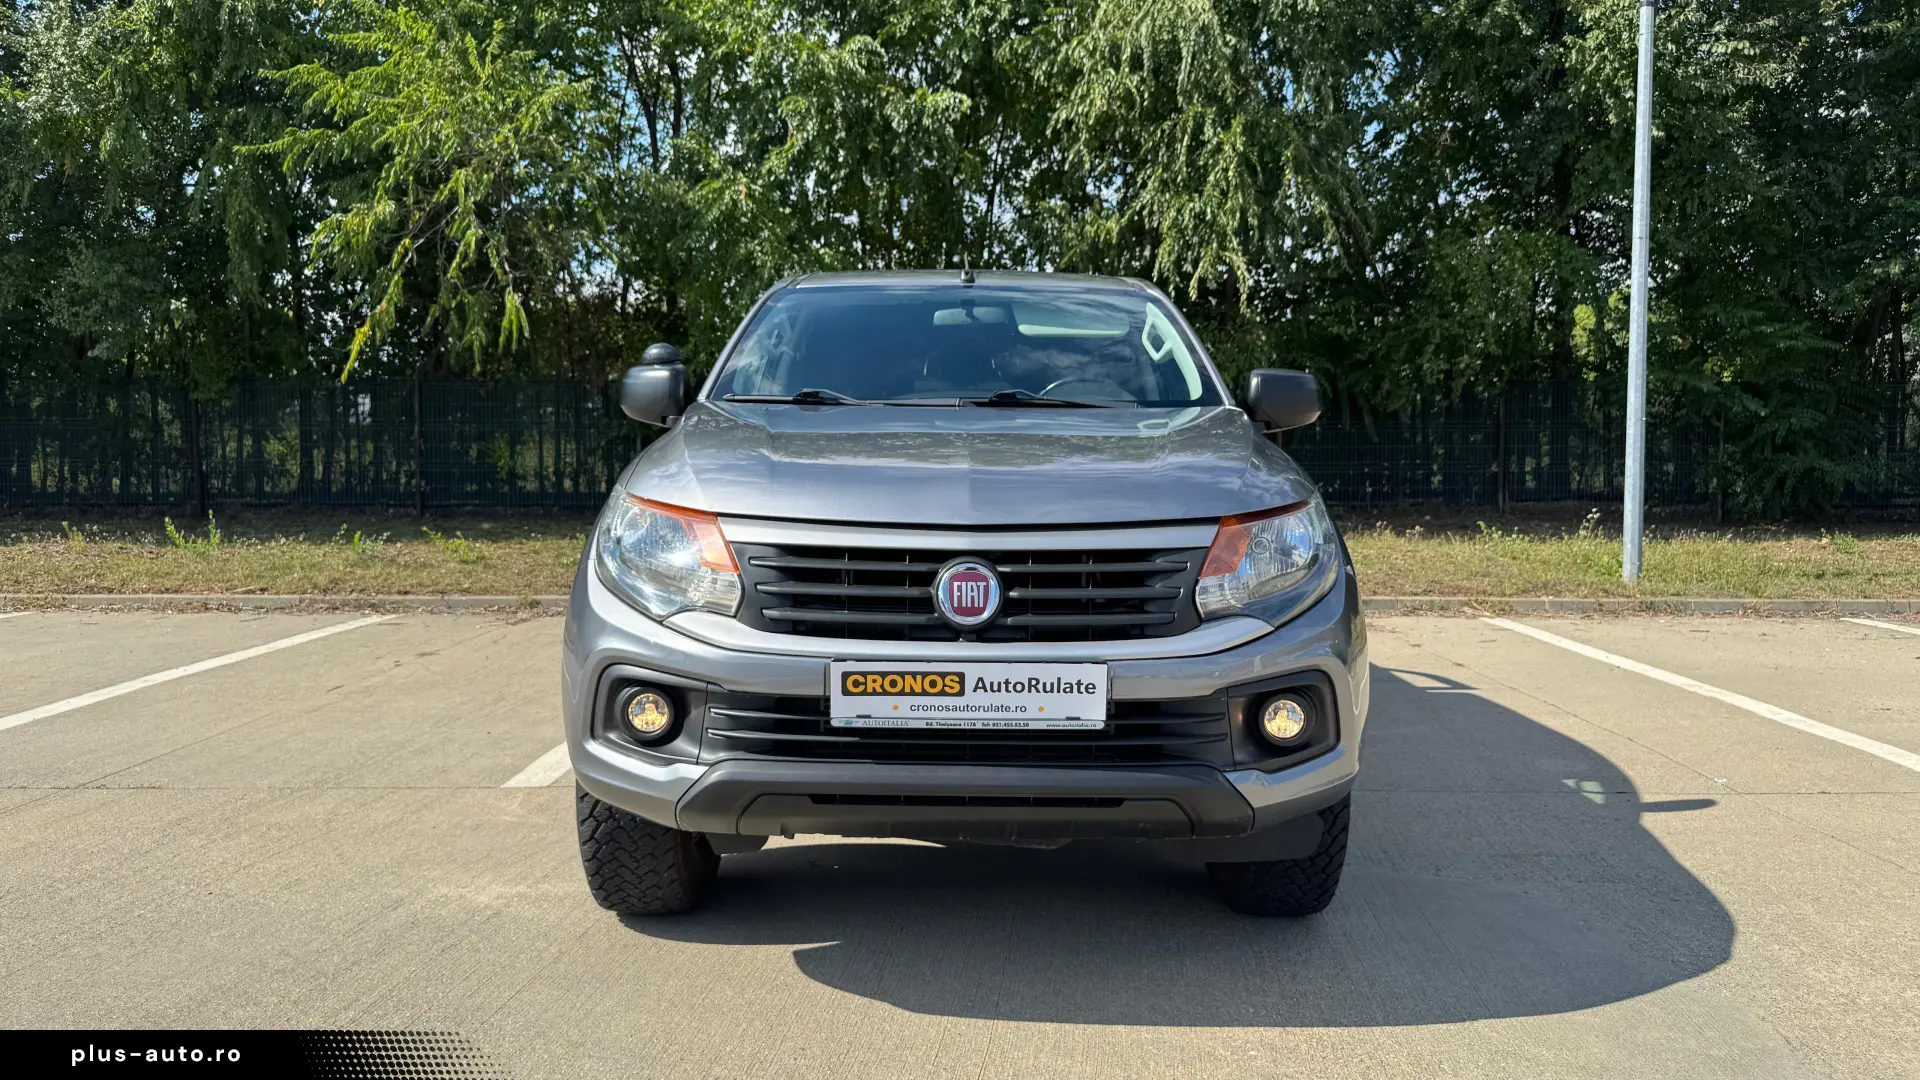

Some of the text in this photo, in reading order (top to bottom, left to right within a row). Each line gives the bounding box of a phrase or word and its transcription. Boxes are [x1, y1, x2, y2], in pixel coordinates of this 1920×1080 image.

[953, 581, 987, 608] FIAT
[846, 674, 1097, 695] CRONOS AutoRulate
[909, 703, 1027, 713] cronosautorulate.ro
[862, 719, 909, 727] AUTOITALIA
